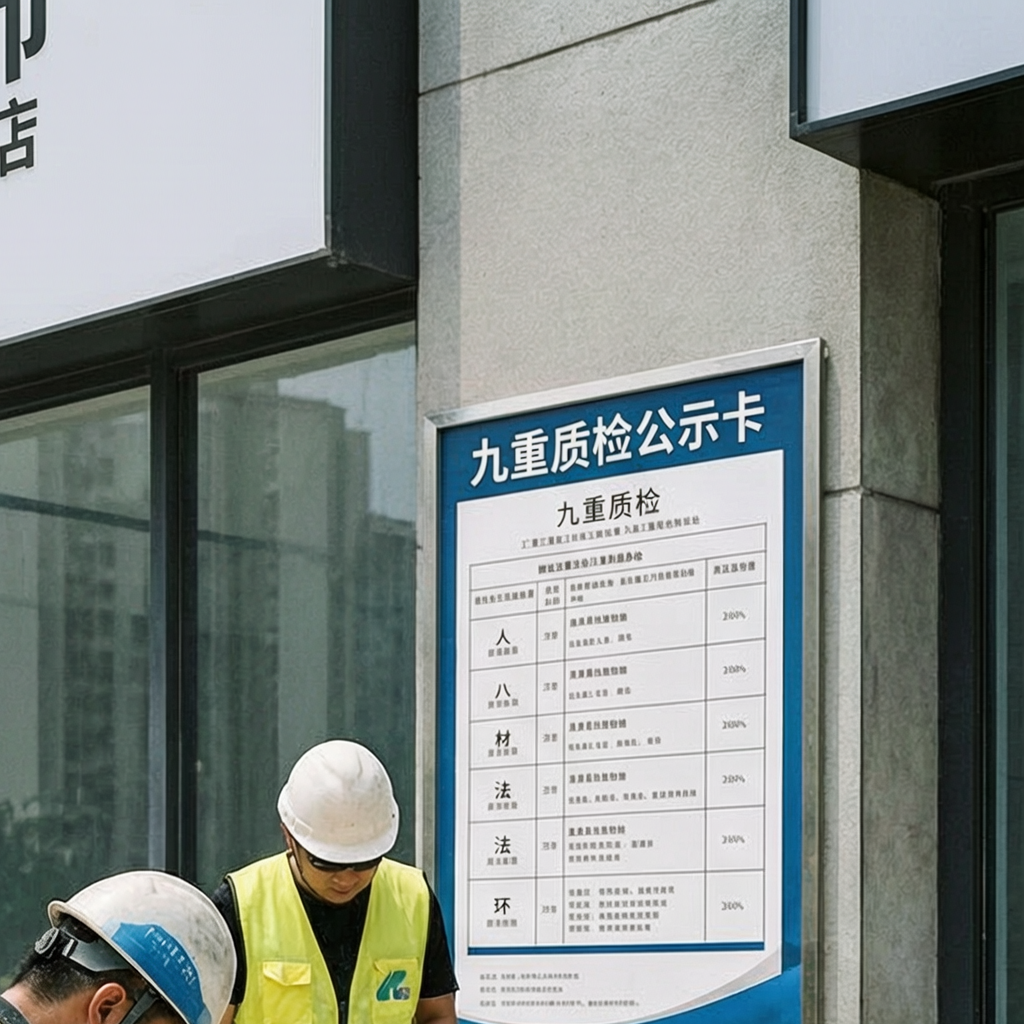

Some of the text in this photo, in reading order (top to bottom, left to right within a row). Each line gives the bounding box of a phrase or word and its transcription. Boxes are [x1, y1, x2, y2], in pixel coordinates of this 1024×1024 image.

[469, 390, 765, 488] 九重质检公示卡
[556, 487, 661, 528] 九重质检
[495, 628, 511, 646] 人
[495, 683, 512, 698] 八
[494, 729, 511, 748] 材
[494, 781, 512, 800] 法
[493, 836, 512, 854] 法
[493, 897, 511, 915] 环
